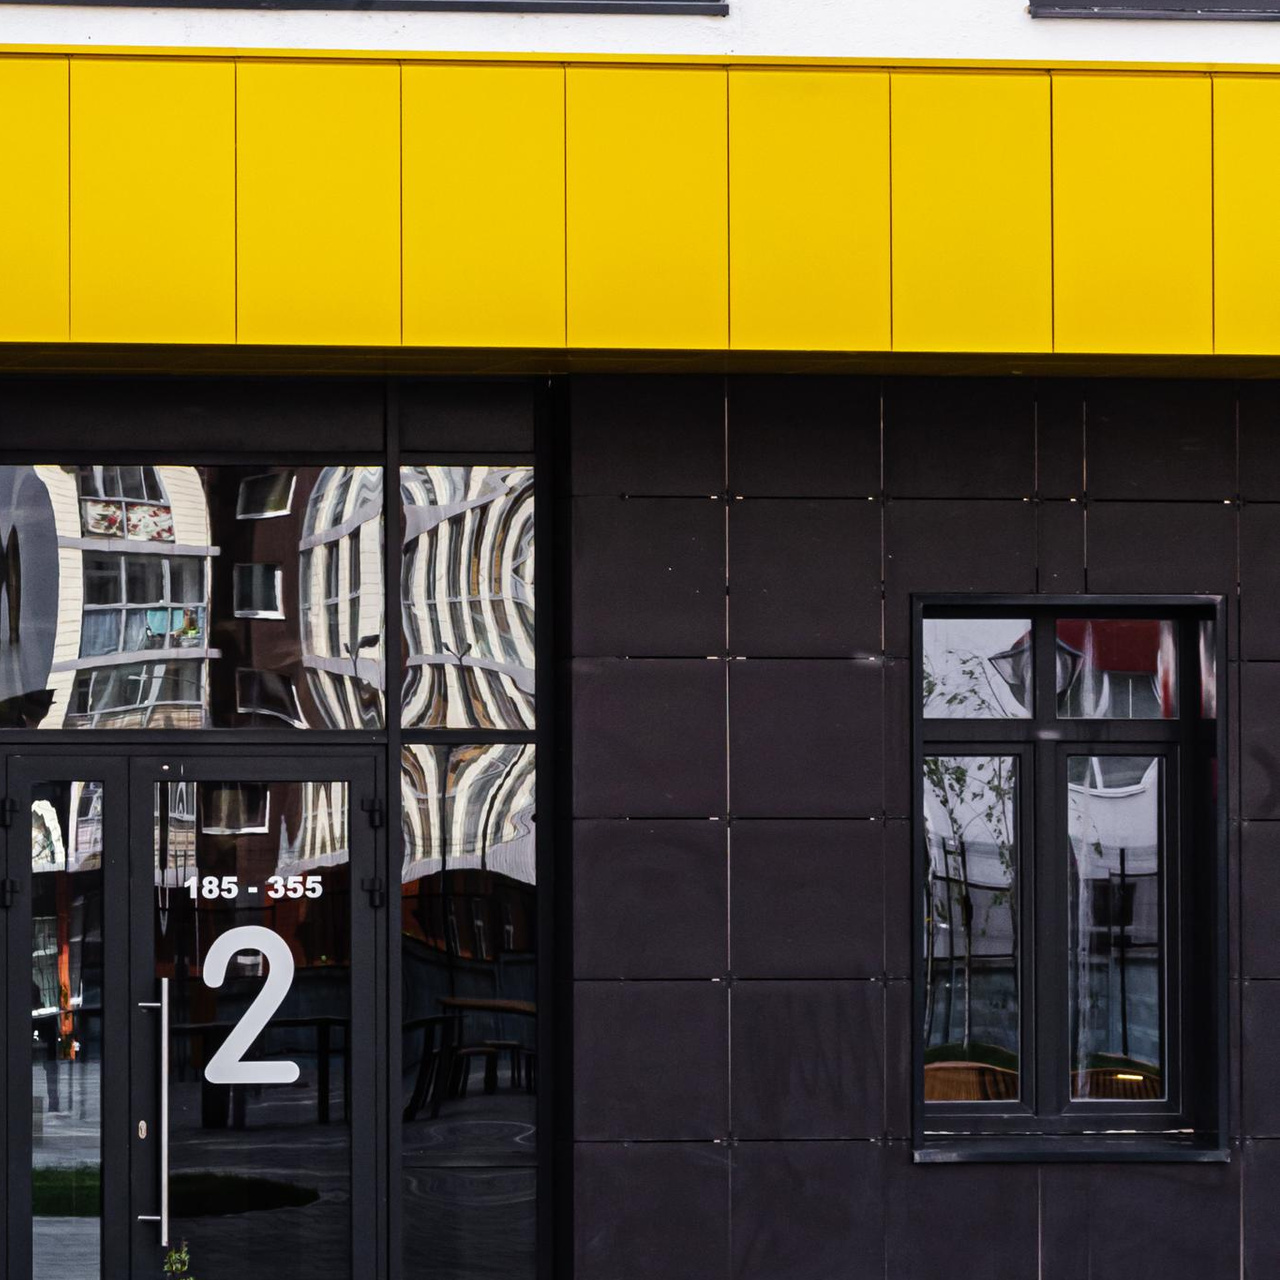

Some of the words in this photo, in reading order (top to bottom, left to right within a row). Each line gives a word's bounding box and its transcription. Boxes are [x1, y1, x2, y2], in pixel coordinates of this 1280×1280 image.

[184, 876, 239, 899] 185
[268, 876, 323, 899] 355
[203, 925, 300, 1084] 2
